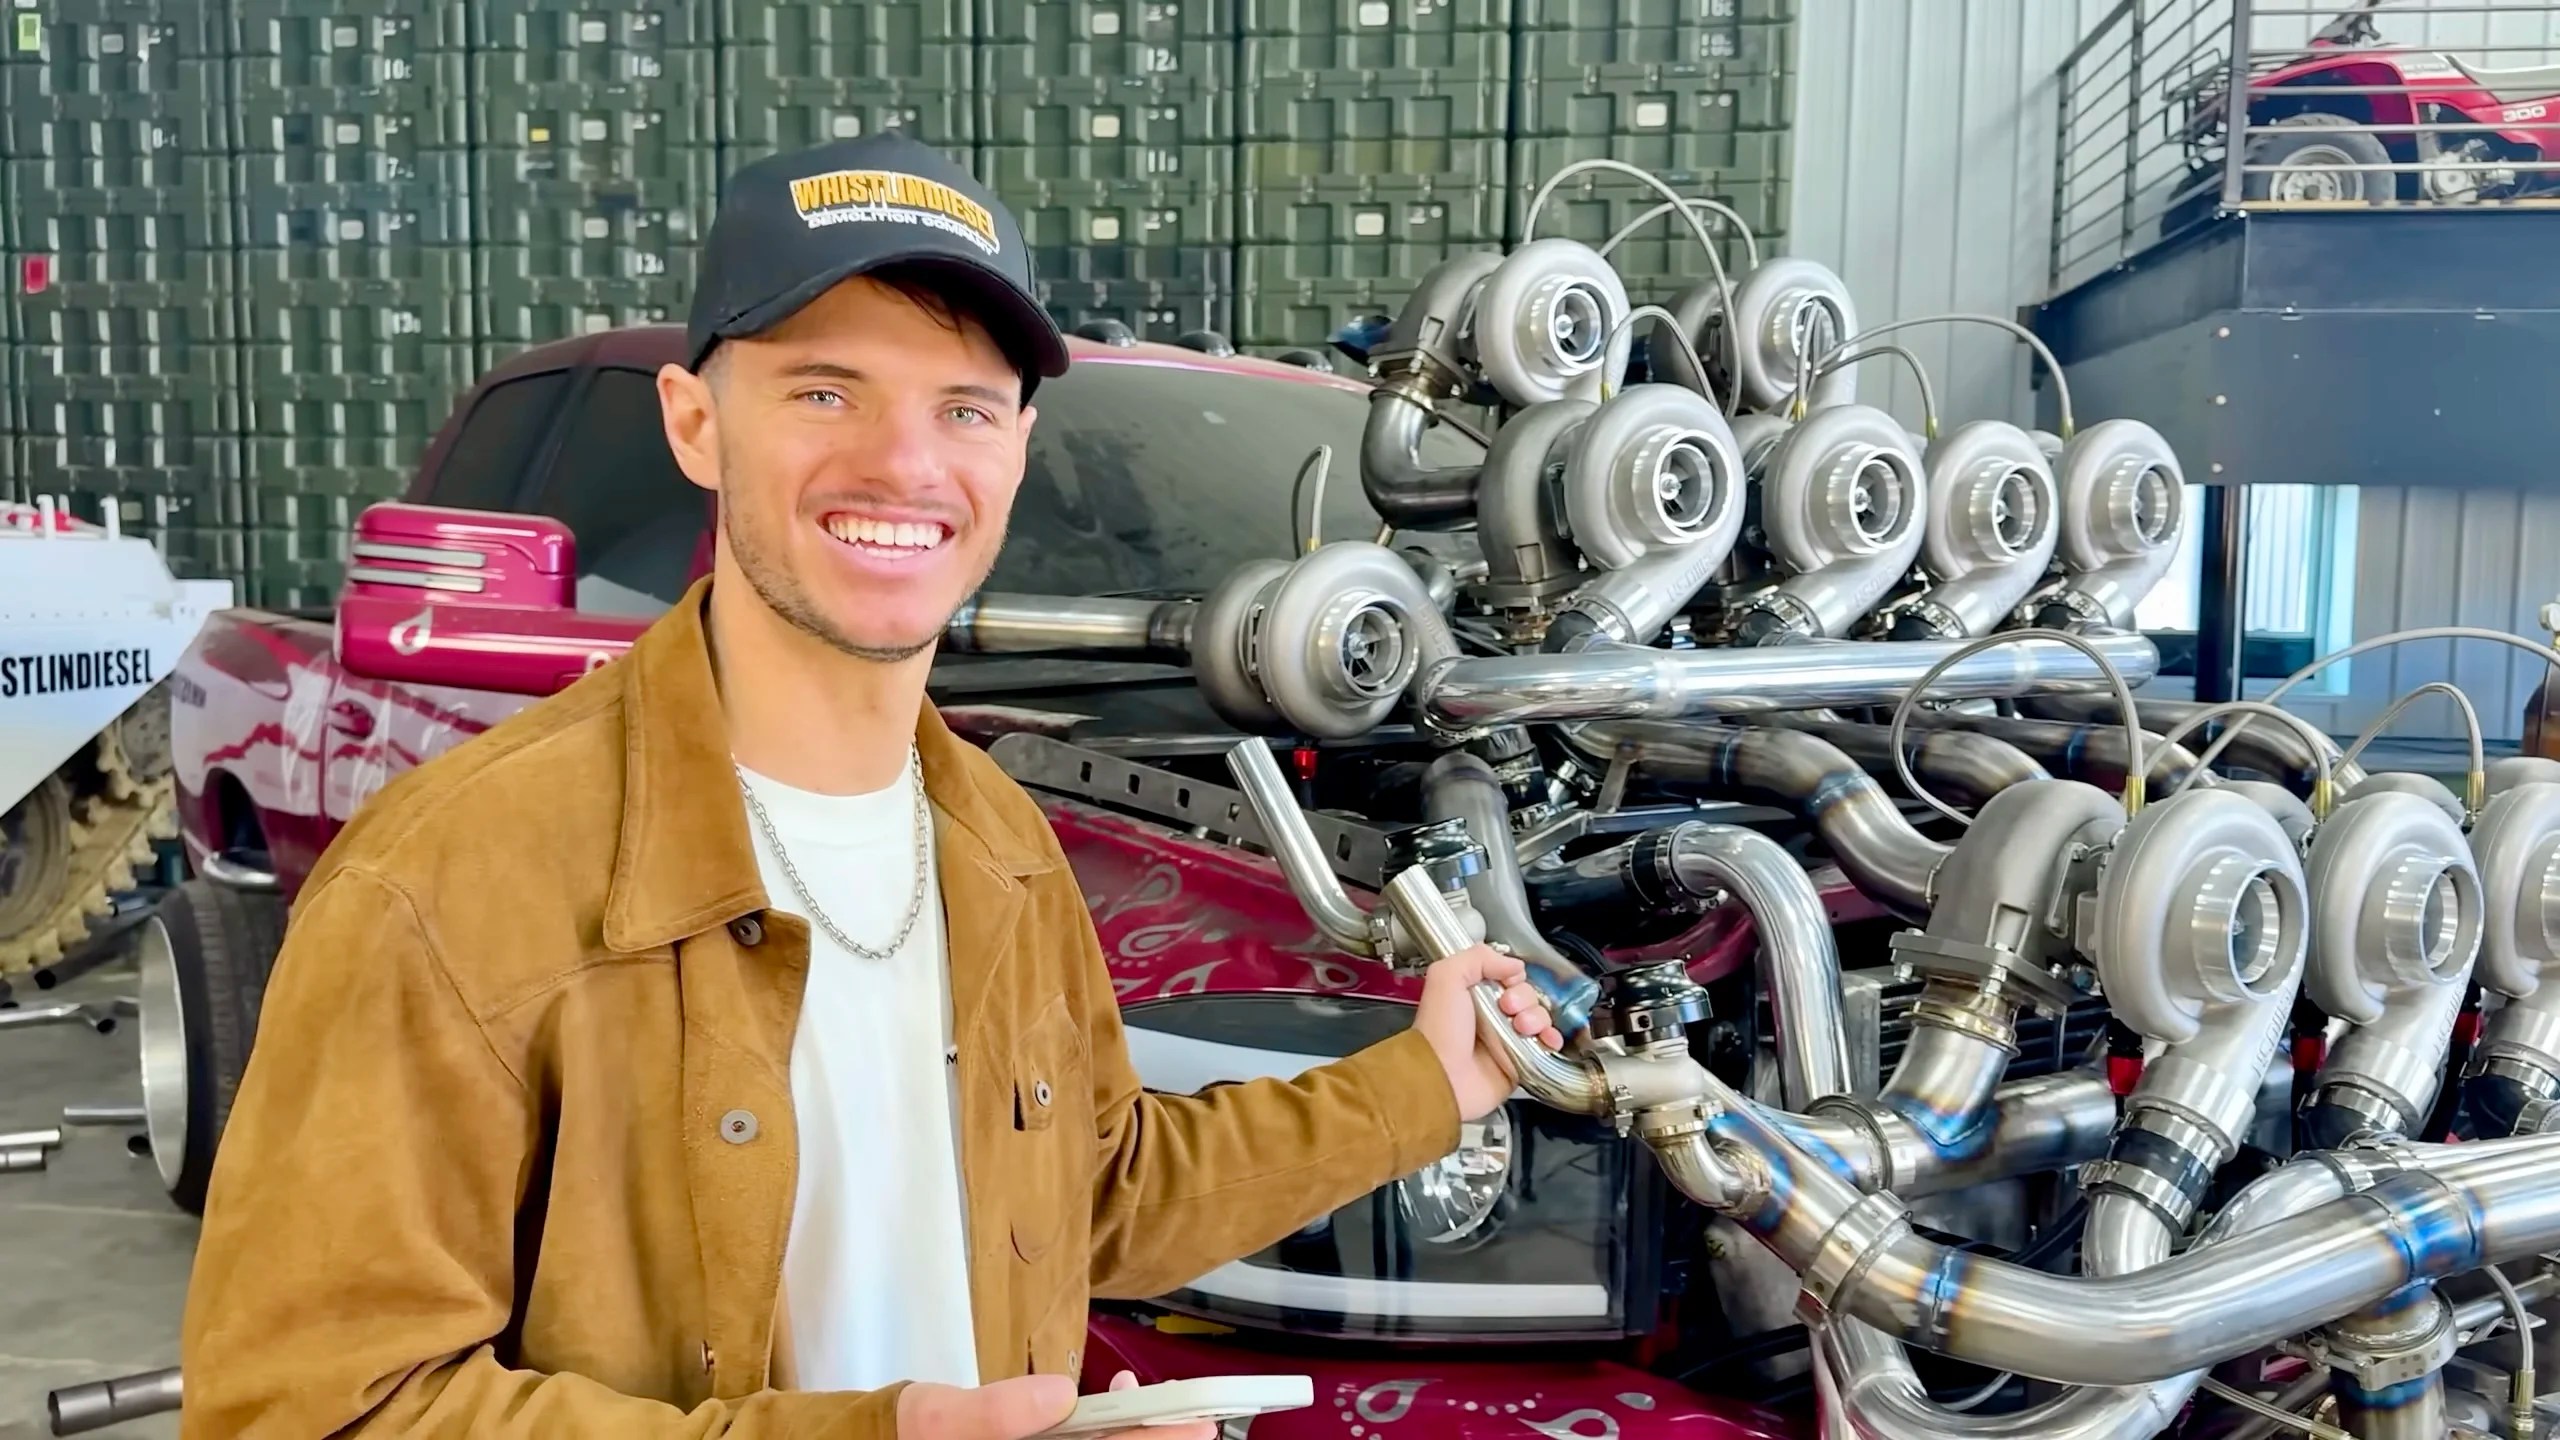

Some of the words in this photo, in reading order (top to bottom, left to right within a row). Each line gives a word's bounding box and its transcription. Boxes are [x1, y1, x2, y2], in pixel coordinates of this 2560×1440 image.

[2502, 105, 2546, 122] 300
[795, 173, 996, 241] WHISTLINDIESEL
[808, 209, 917, 229] DEMOLITION
[921, 216, 993, 256] COMPANY
[1, 649, 153, 697] STLINDIESEL
